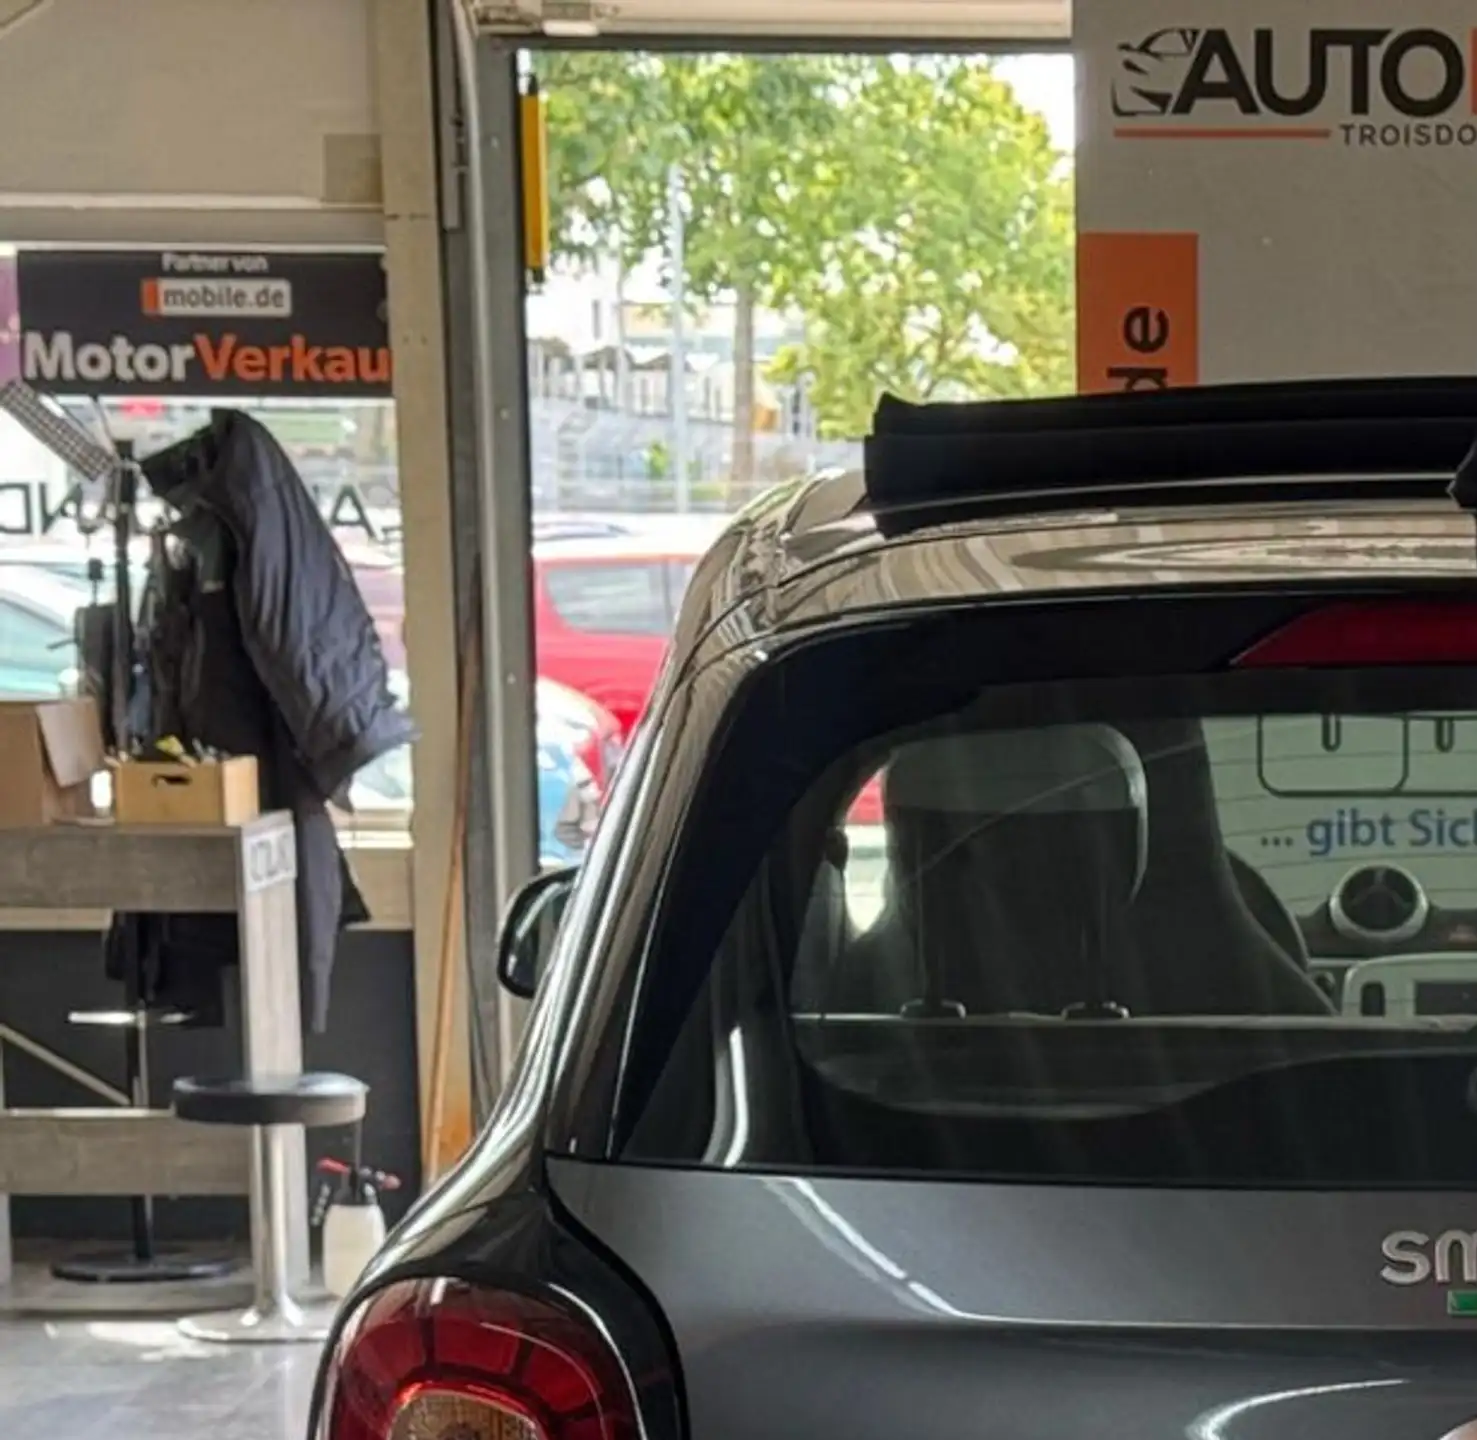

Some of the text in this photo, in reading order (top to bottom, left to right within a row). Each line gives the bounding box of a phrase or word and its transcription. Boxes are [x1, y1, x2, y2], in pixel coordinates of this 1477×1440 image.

[161, 253, 269, 272] Partner von
[163, 285, 285, 309] mobile.de
[1306, 810, 1396, 856] gibt
